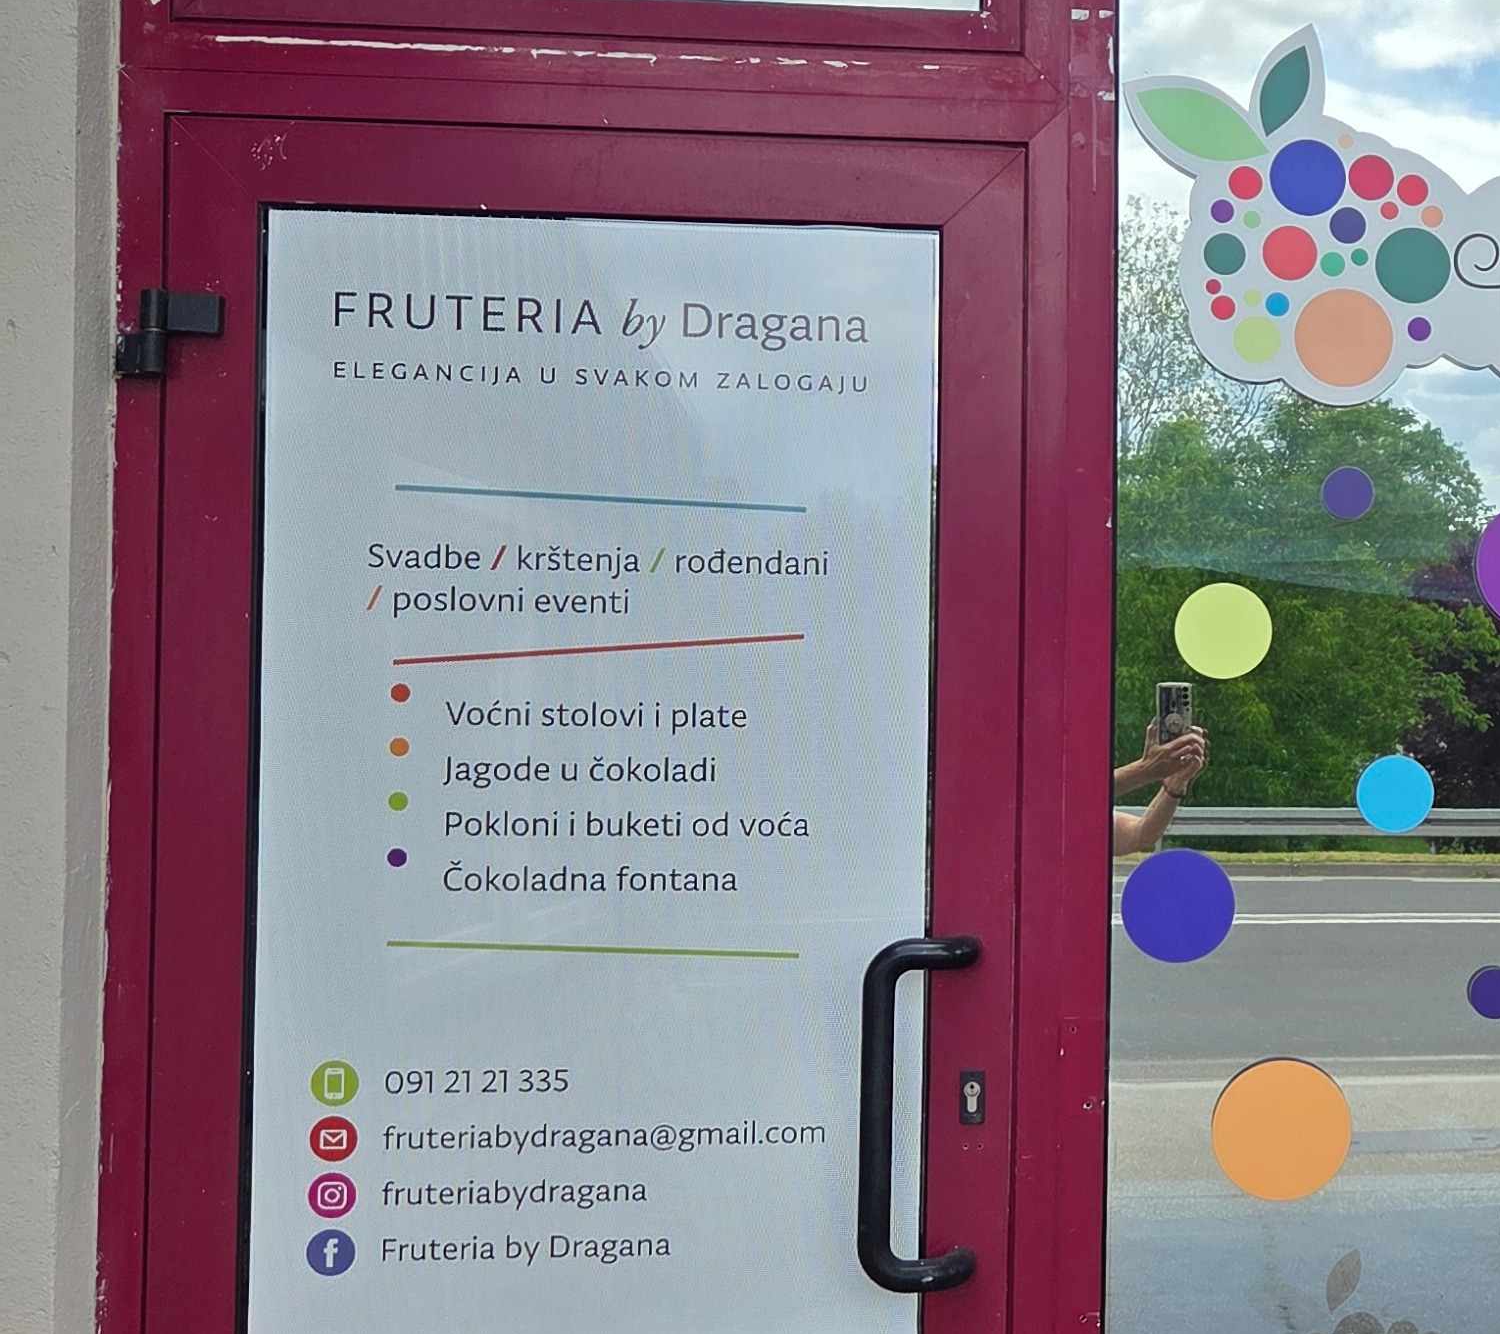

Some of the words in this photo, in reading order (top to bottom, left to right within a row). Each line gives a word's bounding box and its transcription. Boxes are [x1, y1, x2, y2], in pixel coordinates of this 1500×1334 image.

[334, 291, 602, 335] FRUTERIA
[621, 297, 666, 351] by
[682, 302, 869, 352] Dragana
[333, 361, 521, 386] ELEGANCIJA
[540, 366, 556, 385] U
[574, 368, 698, 388] SVAKOM
[716, 372, 867, 395] ZALOGAJU
[367, 543, 481, 570] Svadbe
[517, 544, 641, 580] krštenja
[675, 548, 829, 576] rođendani
[393, 585, 524, 619] poslovni
[534, 588, 630, 615] eventi
[445, 699, 531, 727] Voćni
[541, 701, 644, 728] stolovi
[655, 701, 661, 728] i
[672, 701, 747, 736] plate
[442, 755, 550, 789] Jagode
[561, 762, 578, 782] u
[589, 755, 716, 783] čokoladi
[445, 810, 558, 837] Pokloni
[569, 810, 575, 837] i
[586, 810, 682, 837] buketi
[692, 811, 729, 837] od
[739, 811, 810, 838] voća
[443, 860, 607, 892] Čokoladna
[615, 865, 738, 892] fontana
[385, 1070, 433, 1095] 091
[443, 1069, 471, 1094] 21
[481, 1069, 508, 1094] 21
[518, 1068, 569, 1093] 335
[382, 1119, 825, 1156] fruteriabydragana@gmail.com
[381, 1178, 648, 1211] fruteriabydragana
[382, 1235, 495, 1262] Fruteria
[506, 1234, 541, 1267] by
[550, 1235, 671, 1265] Dragana
